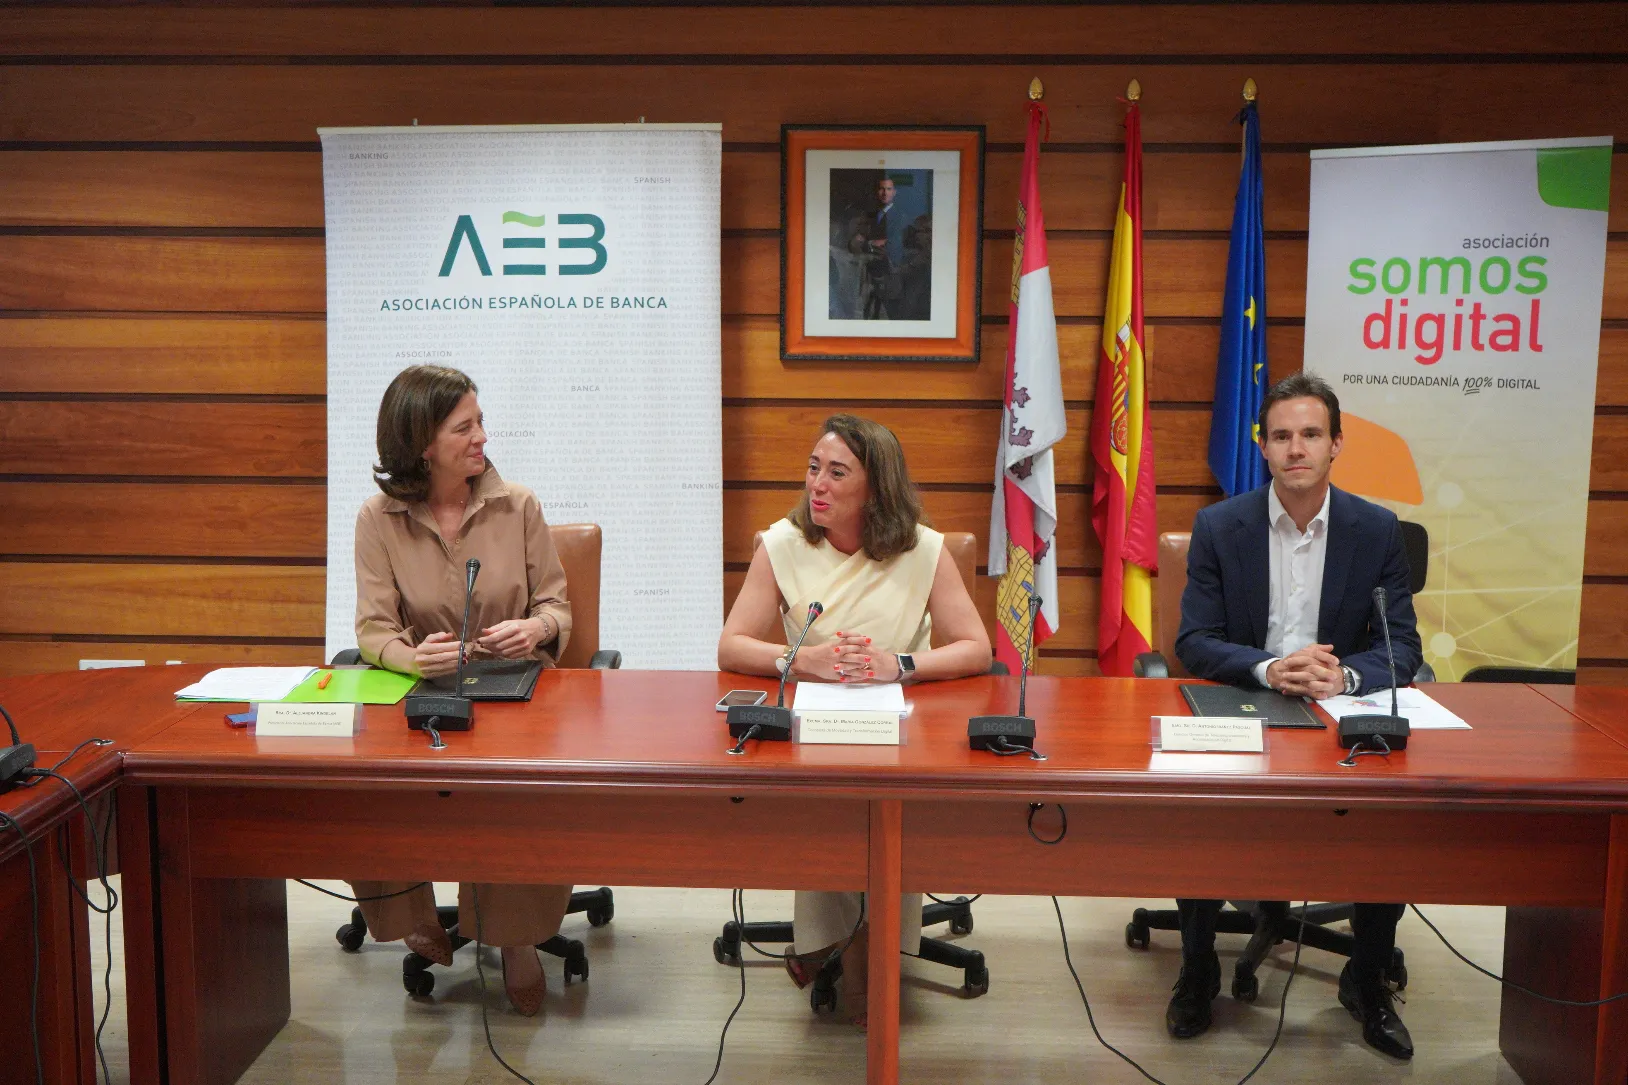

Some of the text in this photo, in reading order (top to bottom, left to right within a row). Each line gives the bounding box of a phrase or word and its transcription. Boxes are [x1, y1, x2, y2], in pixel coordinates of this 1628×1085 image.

[349, 152, 389, 160] BANKING
[1462, 233, 1550, 249] asociación
[1347, 255, 1548, 295] somos
[380, 294, 668, 311] ASOCIACIÓN ESPAÑOLA DE BANCA
[1363, 298, 1543, 365] digital
[395, 350, 452, 358] ASSOCIATION
[1343, 374, 1541, 391] POR UNA CIUDADANÍA 100% DIGITAL
[487, 430, 536, 438] SOCIACIÓN
[682, 482, 720, 490] BANKING
[543, 500, 589, 509] ESPAÑOLA
[633, 588, 670, 596] SPANISH
[418, 703, 455, 713] BOSCH
[982, 722, 1022, 733] BOSCH
[1357, 721, 1397, 732] BOSCH
